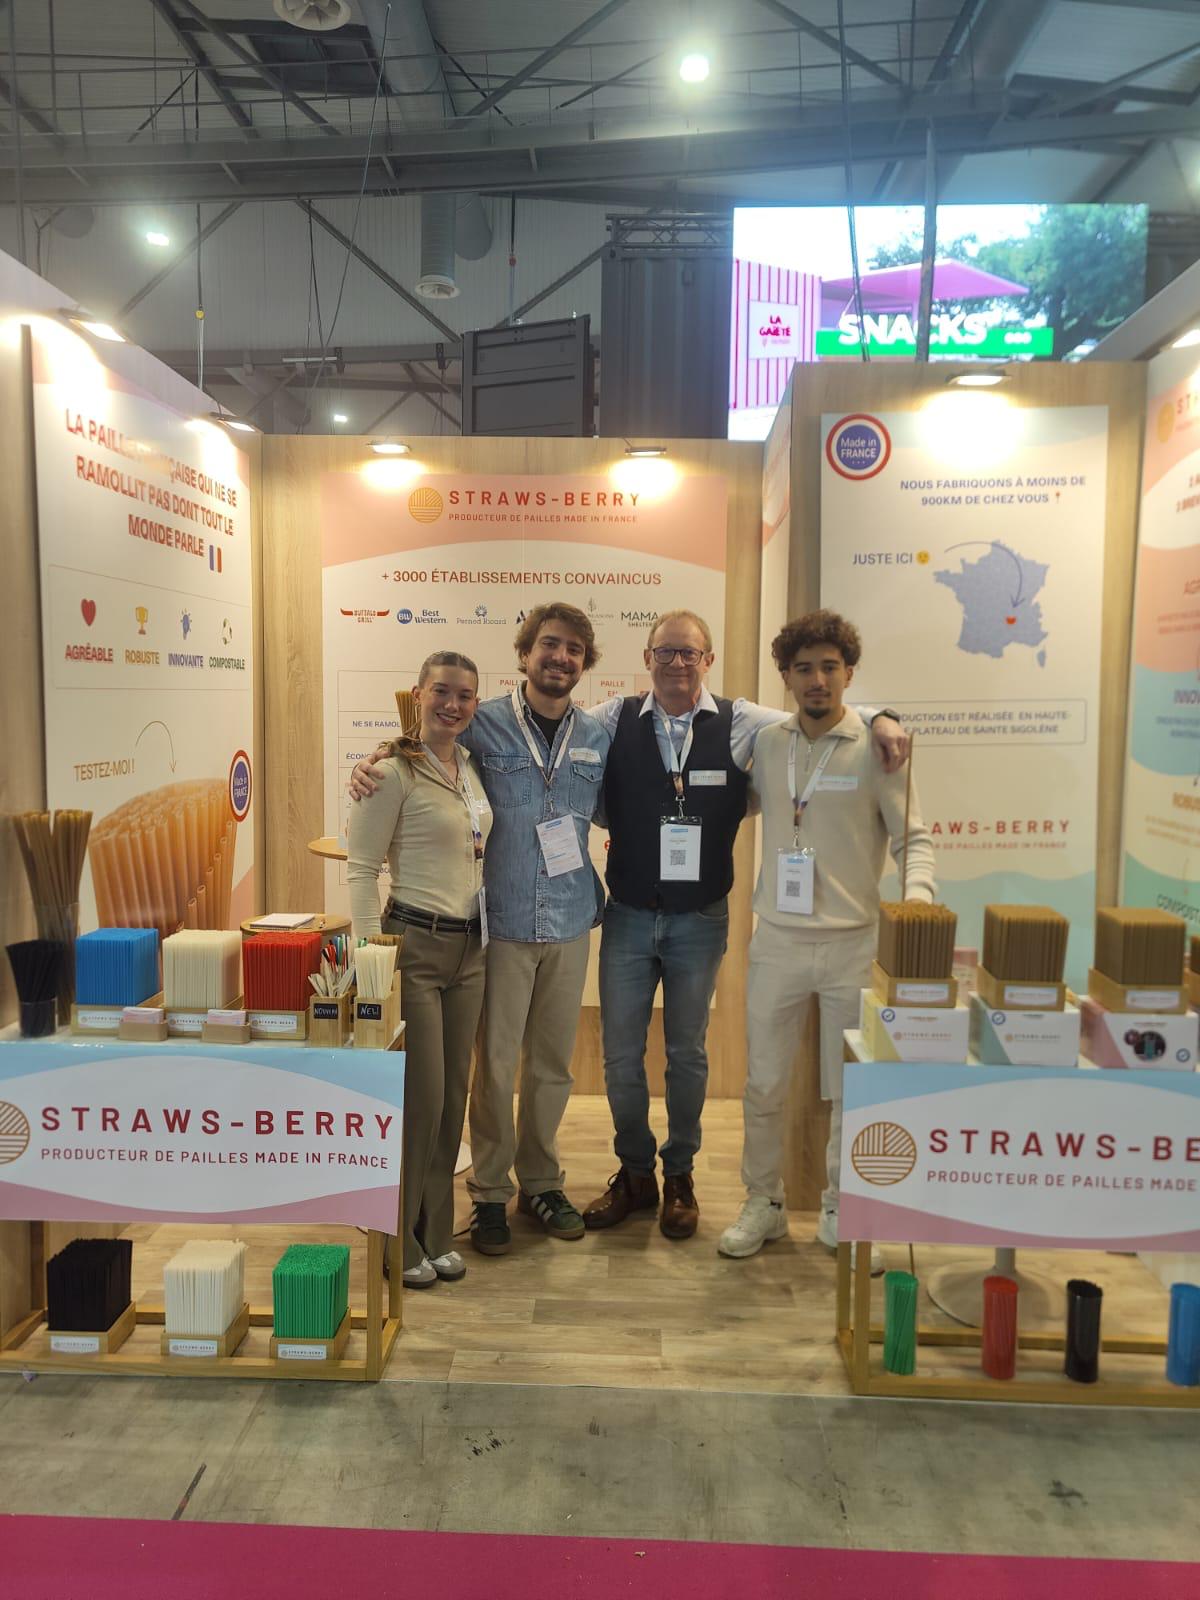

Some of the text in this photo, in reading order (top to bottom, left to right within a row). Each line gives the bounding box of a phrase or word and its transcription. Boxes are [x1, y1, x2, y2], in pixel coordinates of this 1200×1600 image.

[770, 315, 781, 324] LA
[65, 408, 87, 438] LA
[841, 437, 876, 447] Made in
[841, 448, 876, 458] FRANCE
[900, 475, 1086, 490] NOUS FABRIQUONS À MOINS DE
[76, 455, 234, 536] RAMOLLIT PAS DONT TOUT LE
[449, 490, 639, 506] STRAWS-BERRY
[921, 493, 1049, 506] 900KM DE CHEZ VOUS
[449, 513, 637, 523] PRODUCTEUR DE PAILLES MADE IN FRANCE
[128, 513, 204, 557] MONDE PARLE
[853, 553, 913, 565] JUSTE ICI
[393, 570, 428, 583] 3000
[432, 568, 561, 584] ÉTABLISSEMENTS
[564, 572, 662, 585] CONVAINCUS
[422, 609, 440, 617] Best
[621, 611, 659, 621] MAMA
[65, 642, 114, 662] AGRÉABLE
[125, 649, 160, 666] ROBUSTE
[168, 652, 204, 668] INNOVANTE
[208, 656, 246, 671] COMPOSTABLE
[600, 680, 625, 688] PAILLE
[352, 720, 401, 728] NE SE RAMOL
[957, 726, 971, 735] DE
[931, 819, 1070, 836] AWS-BERRY
[41, 1106, 393, 1140] STRAWS-BERRY
[929, 1128, 1200, 1162] STRAWS-BE
[41, 1148, 388, 1169] PRODUCTEUR DE PAILLES MADE IN FRANCE
[927, 1170, 1197, 1192] PRODUCTEUR DE PAILLES MADE
